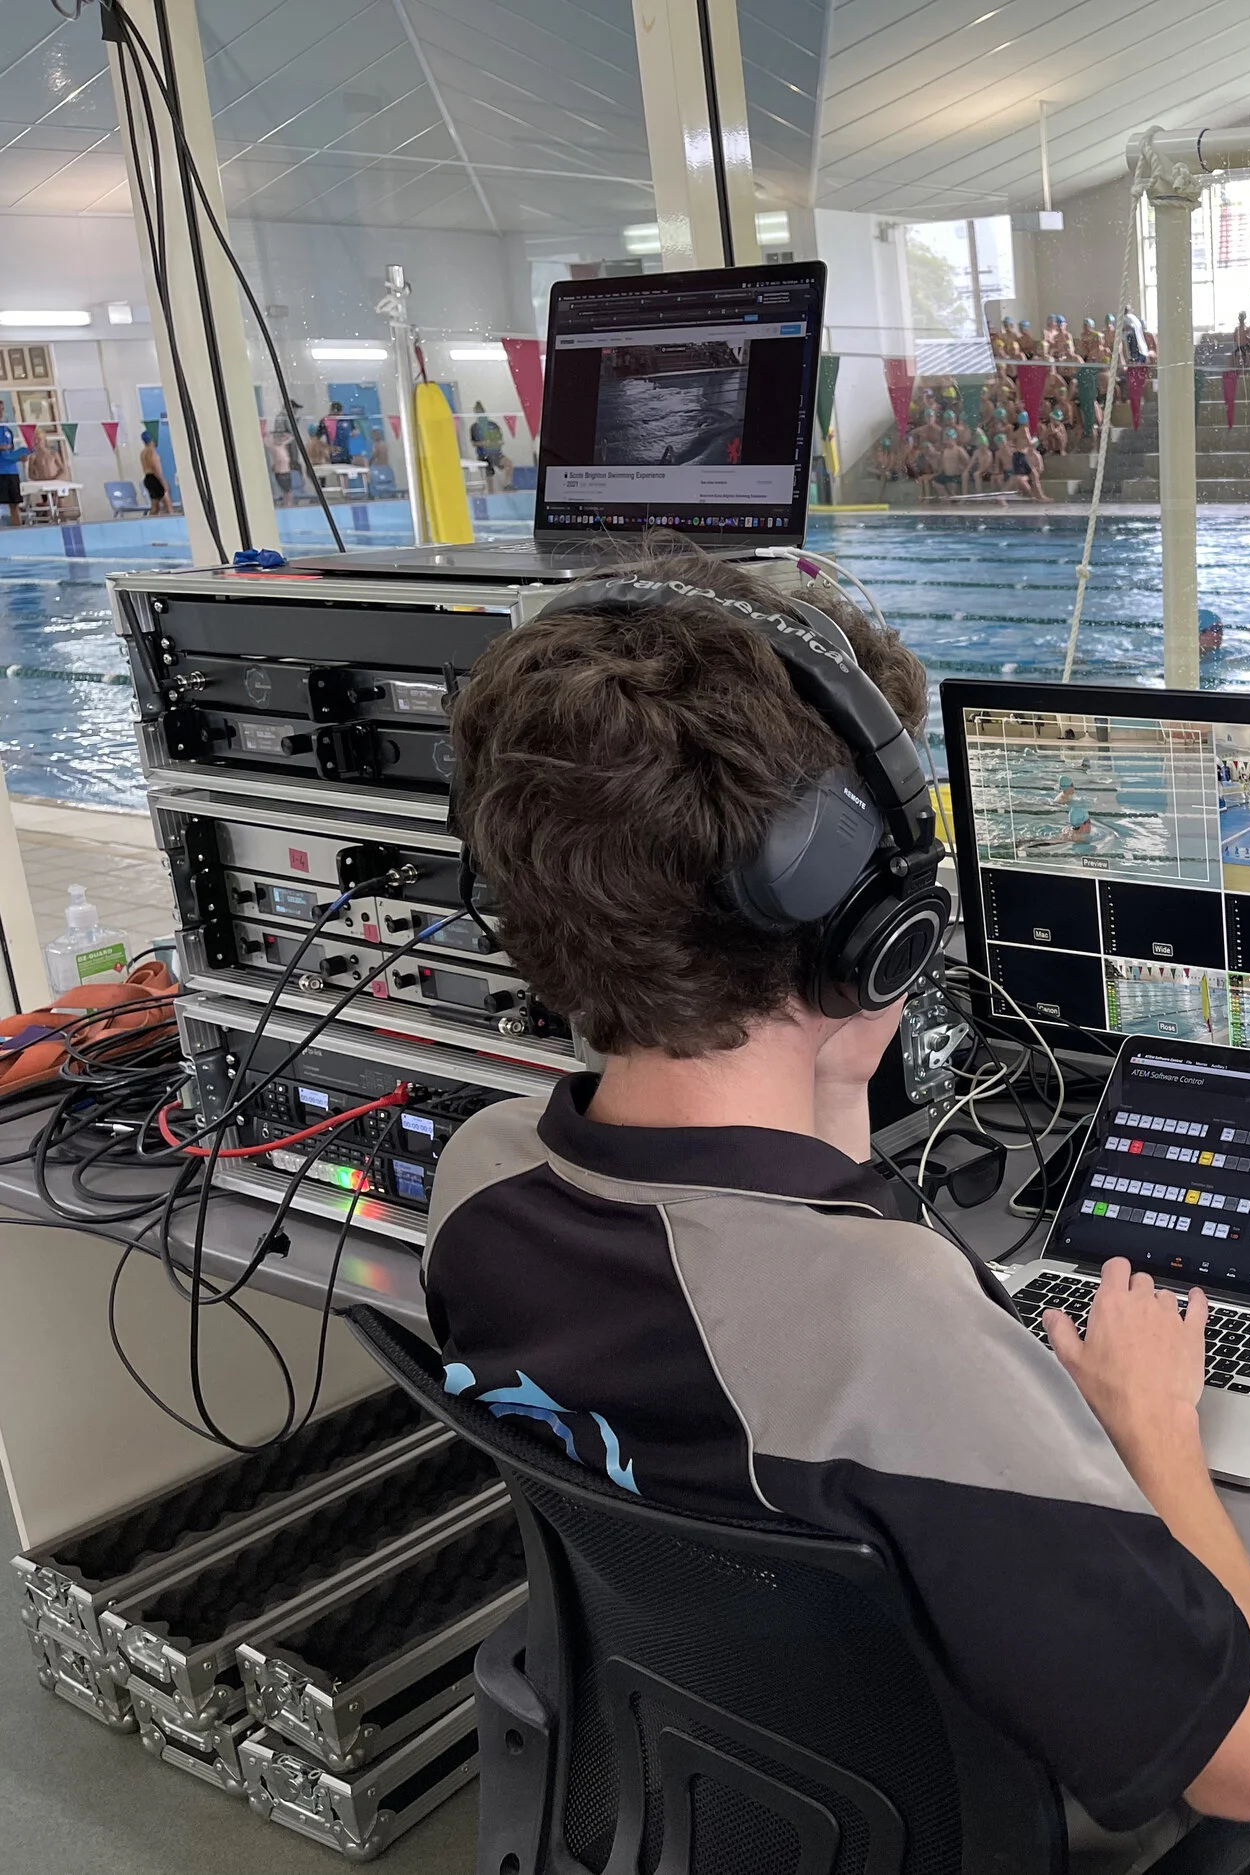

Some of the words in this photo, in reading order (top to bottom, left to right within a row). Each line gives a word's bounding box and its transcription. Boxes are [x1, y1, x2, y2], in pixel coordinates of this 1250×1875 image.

[584, 472, 607, 480] Brighton
[607, 472, 634, 480] Swimming
[635, 472, 666, 480] Experience
[843, 787, 867, 810] REMOTE
[1083, 859, 1108, 868] Preview
[1035, 930, 1049, 938] Mac
[1155, 945, 1170, 954] Wide
[1131, 1069, 1150, 1077] ATEM
[1150, 1071, 1179, 1083] Software
[1179, 1075, 1205, 1086] Control
